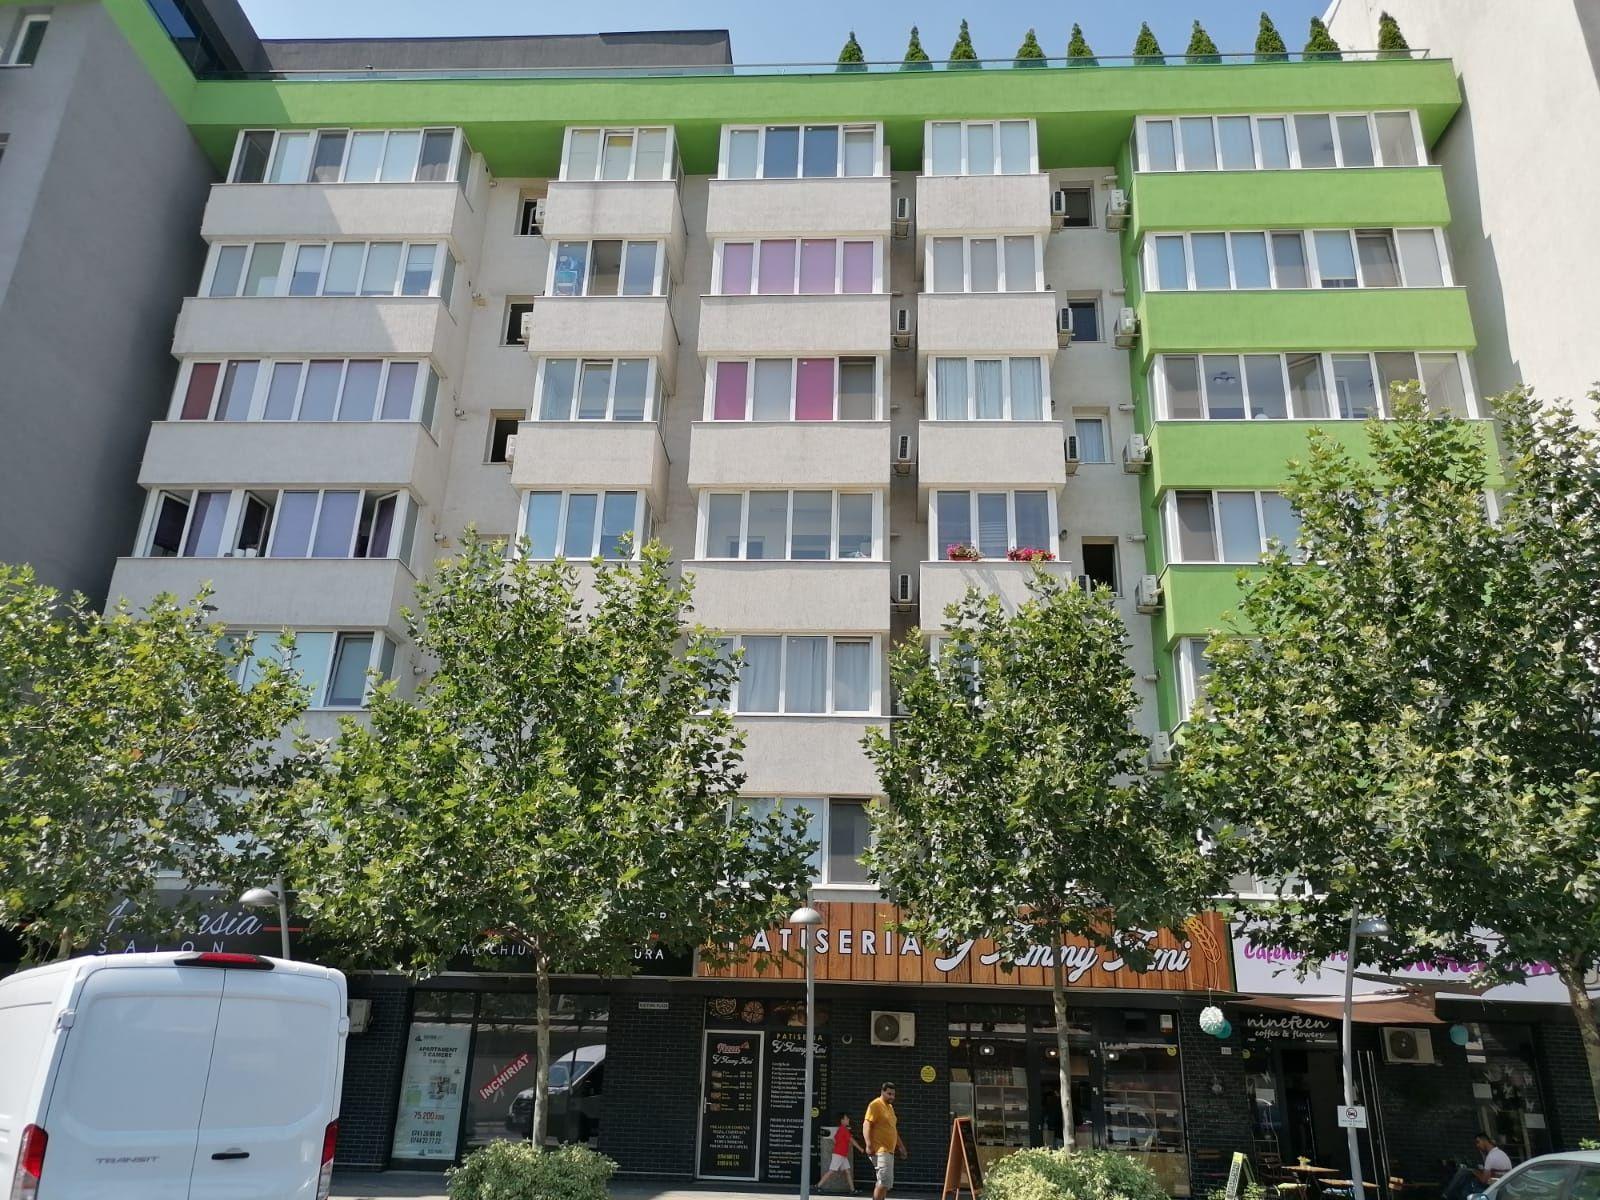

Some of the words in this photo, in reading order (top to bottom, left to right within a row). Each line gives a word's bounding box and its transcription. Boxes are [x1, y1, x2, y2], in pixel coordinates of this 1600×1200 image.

[722, 927, 922, 957] ATISERIA
[1247, 1014, 1330, 1030] nineteen
[776, 1033, 823, 1041] PATISEIA
[1255, 1029, 1280, 1039] coffee
[1282, 1029, 1290, 1039] &
[95, 1155, 160, 1164] TRANSIT
